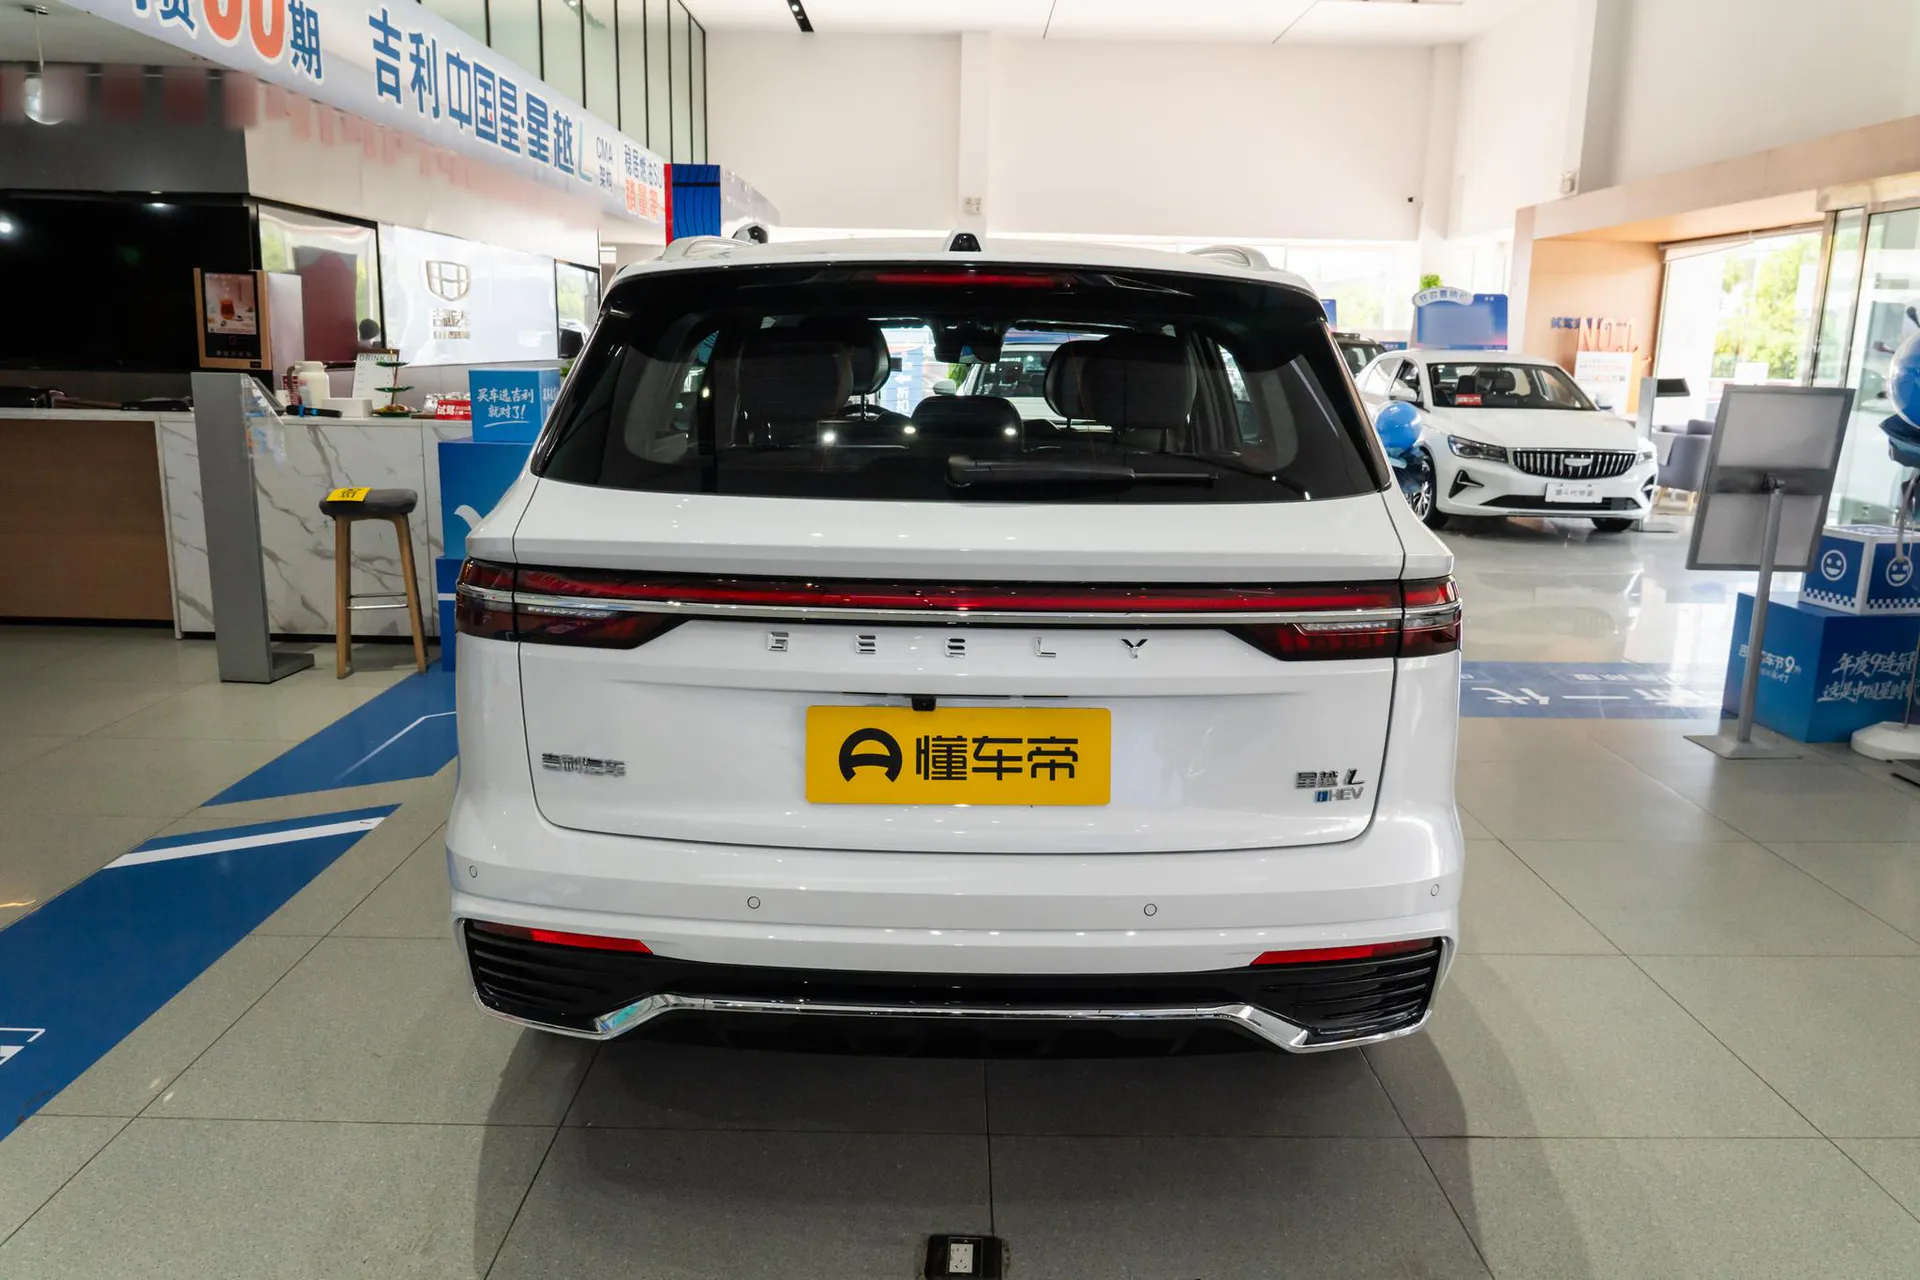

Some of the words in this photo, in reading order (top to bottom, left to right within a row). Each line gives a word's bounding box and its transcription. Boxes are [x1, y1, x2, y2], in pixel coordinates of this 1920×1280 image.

[476, 387, 534, 404] 买车选吉利
[768, 630, 1148, 660] GEELY
[542, 752, 627, 778] 吉利汽车
[915, 735, 1079, 782] 懂车帝
